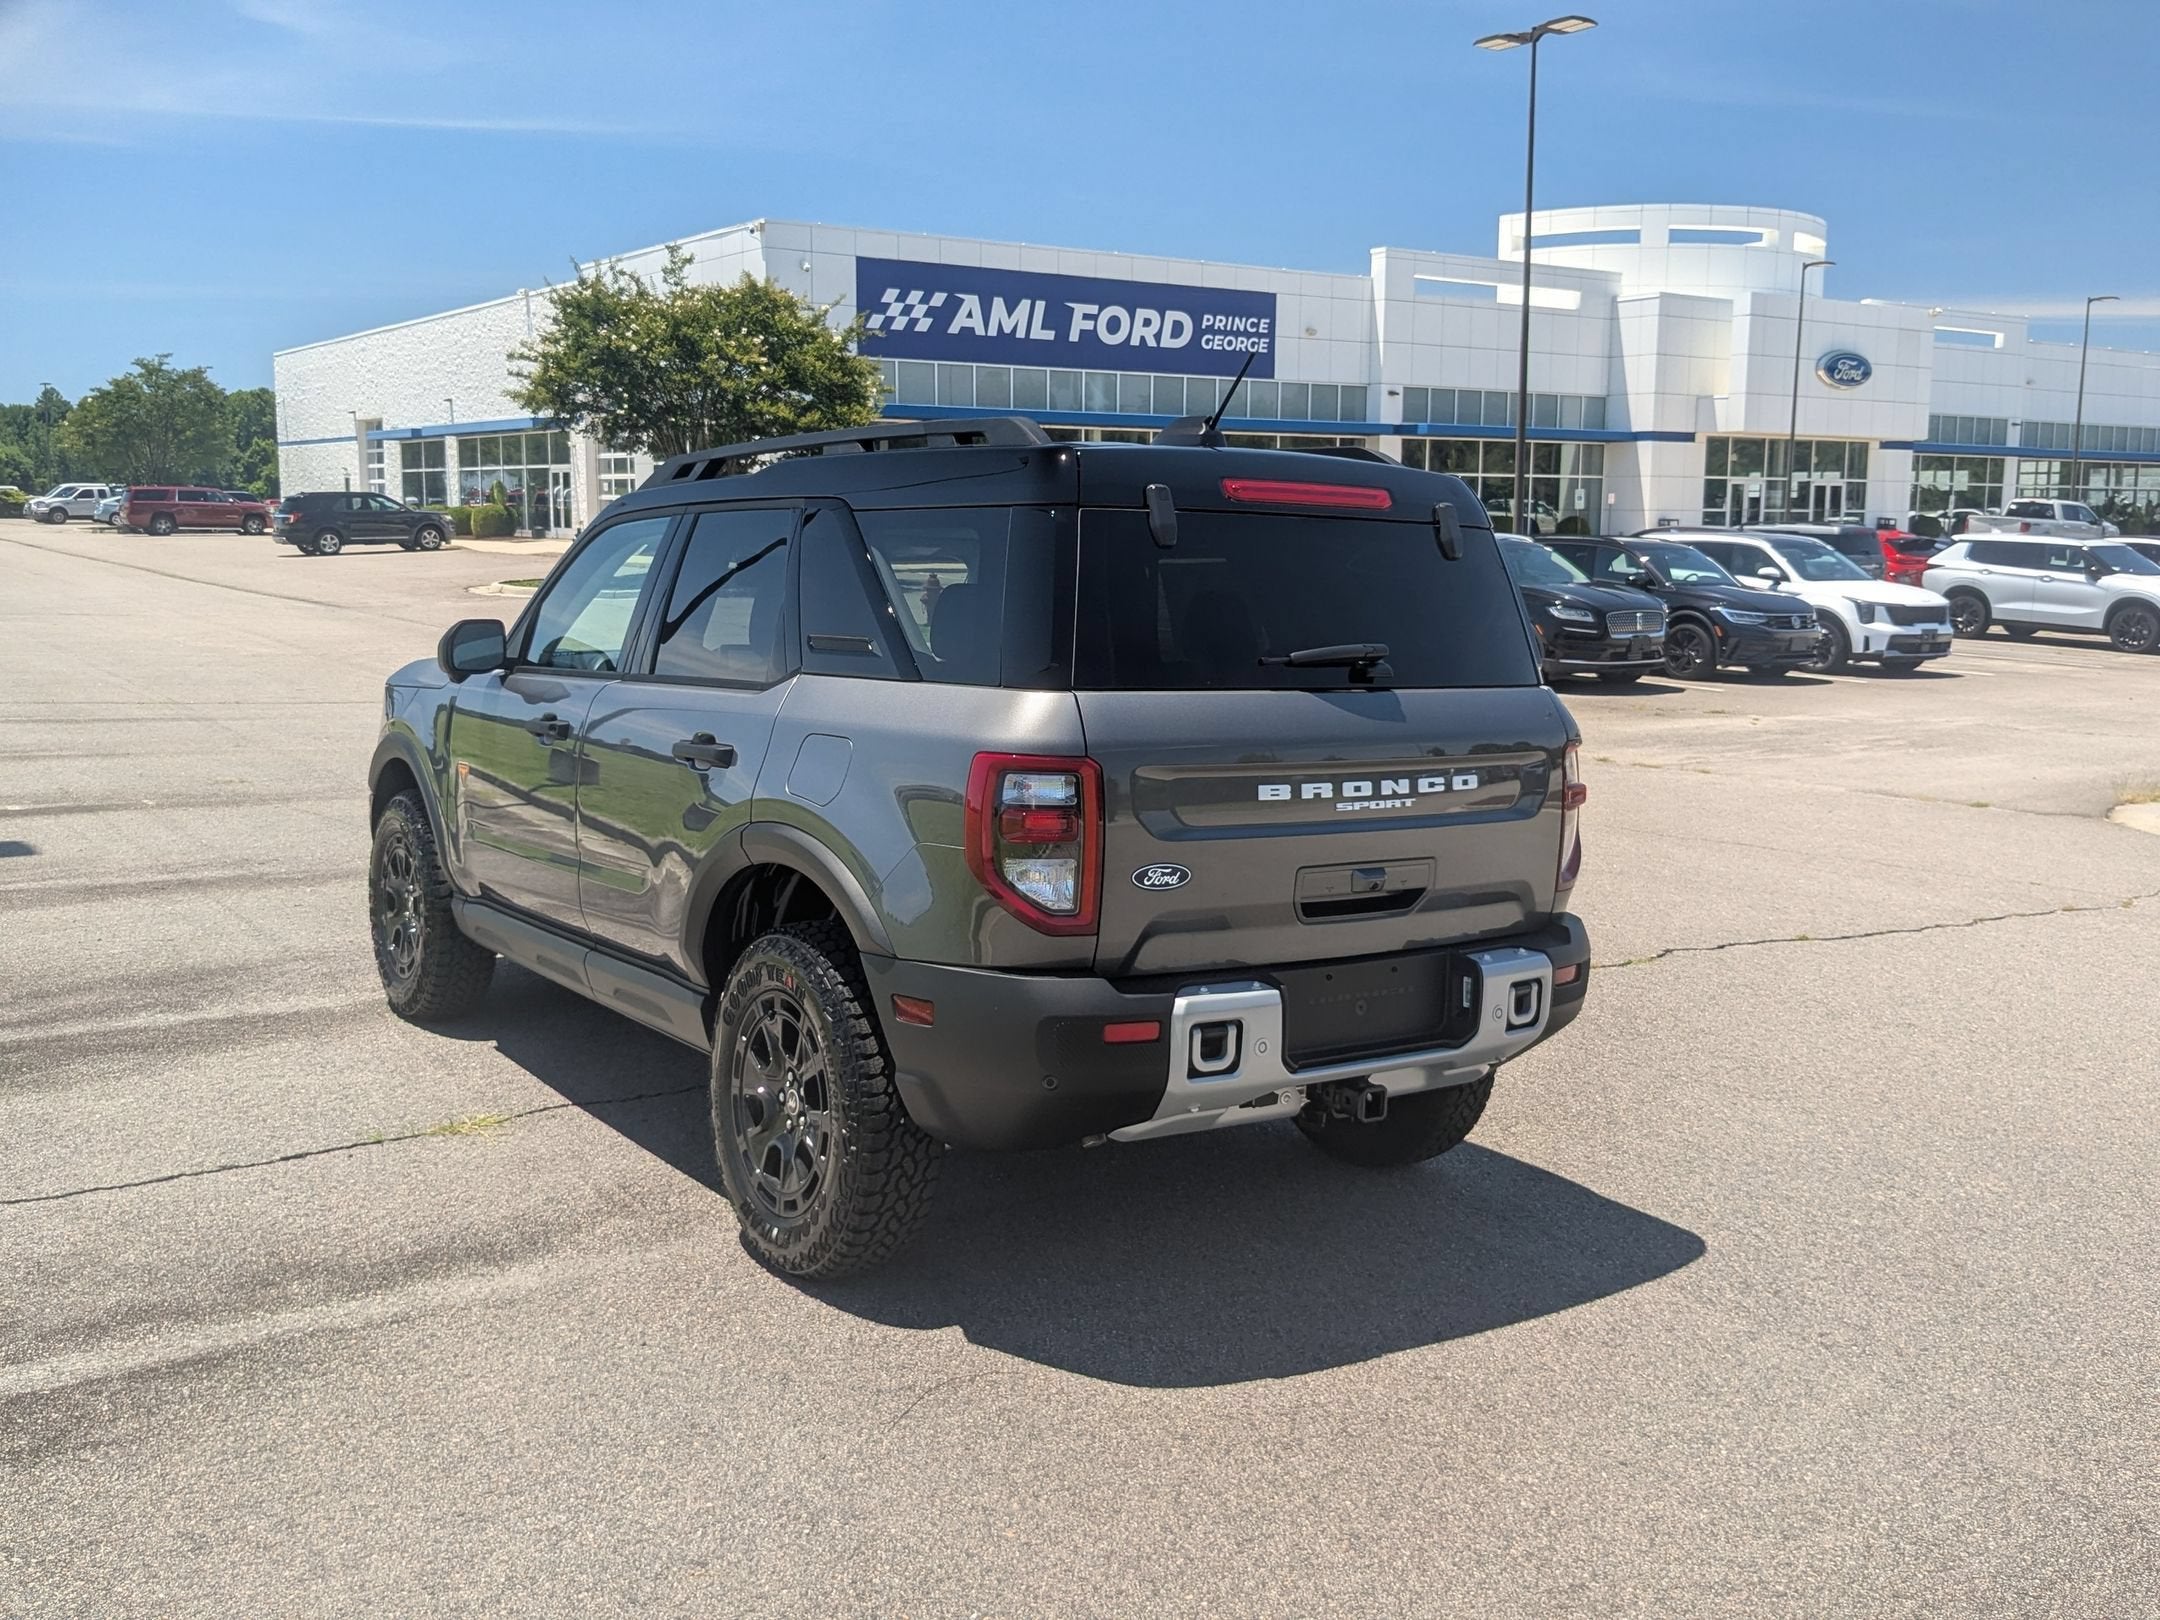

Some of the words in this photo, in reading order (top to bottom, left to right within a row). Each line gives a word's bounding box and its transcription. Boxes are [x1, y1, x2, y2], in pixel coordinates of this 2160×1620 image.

[947, 293, 1056, 341] AML
[1063, 302, 1193, 349] FORD
[1201, 314, 1270, 334] PRINCE
[1200, 334, 1269, 353] GEORGE
[1834, 359, 1865, 380] Ford
[1257, 773, 1480, 801] BRONCO
[1335, 798, 1416, 812] SPORT
[1143, 867, 1181, 886] Ford
